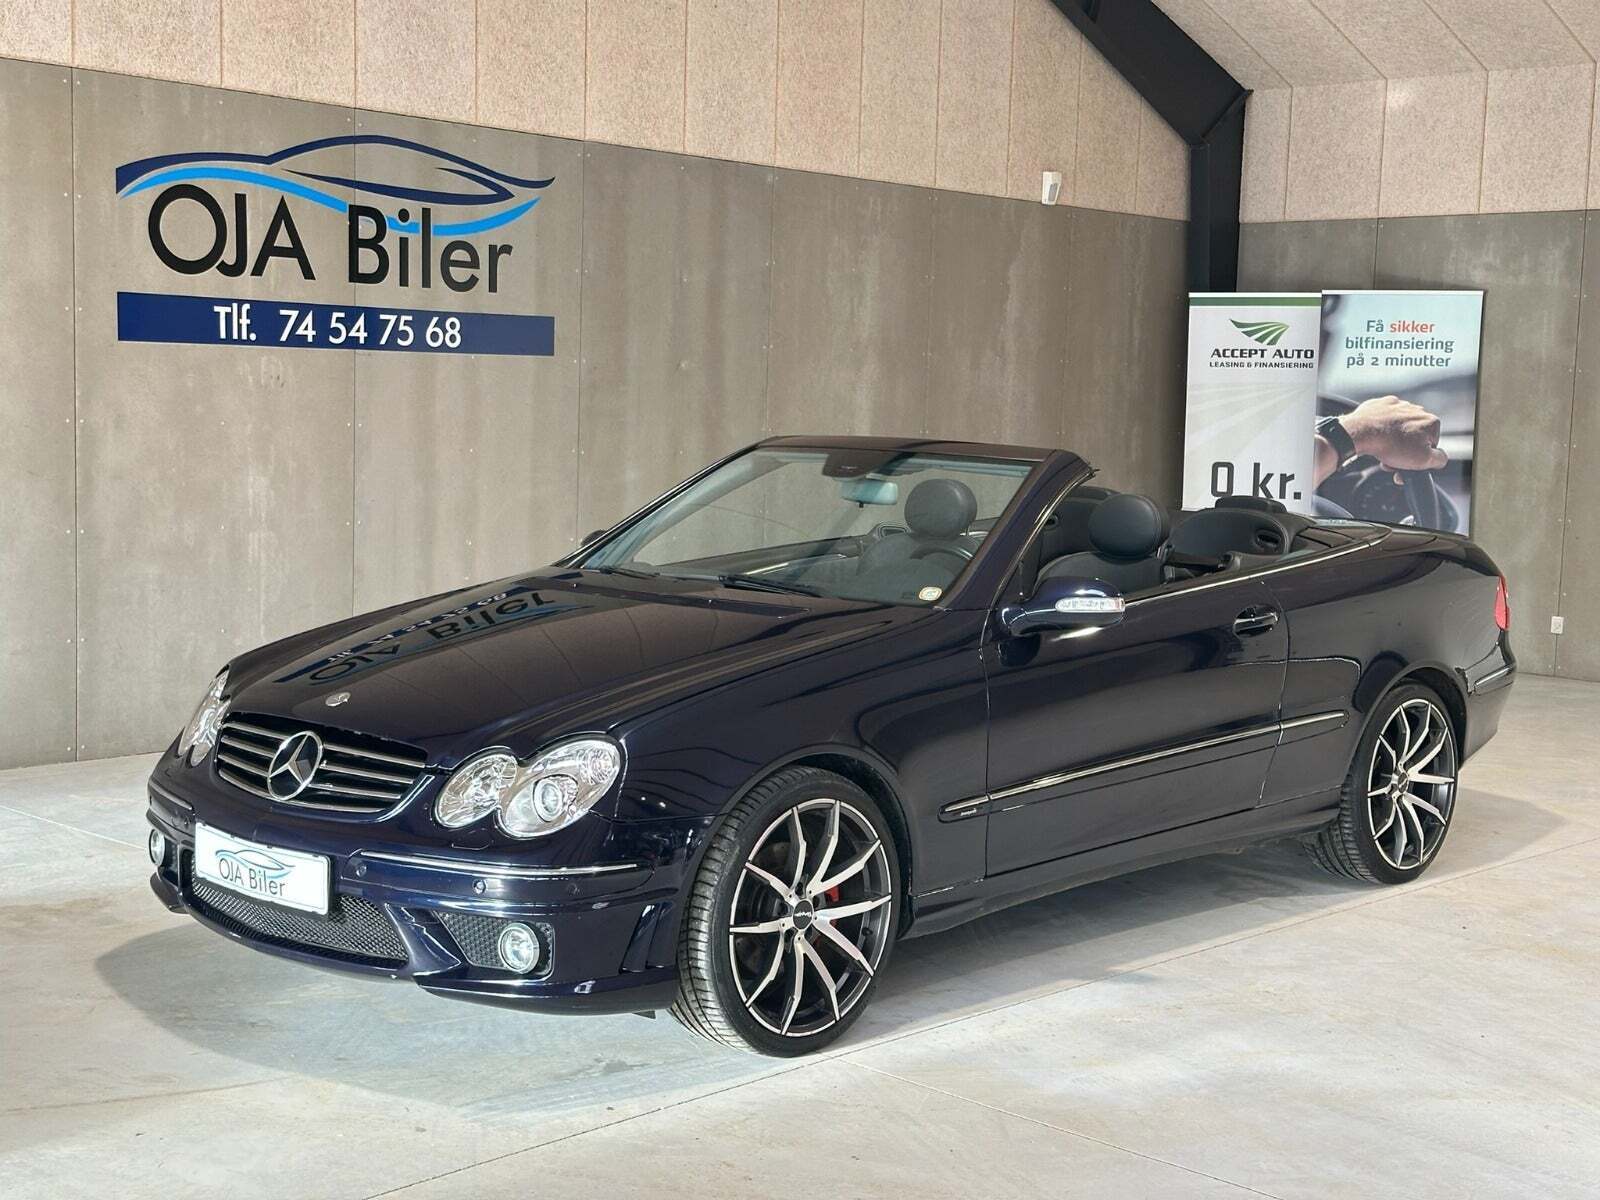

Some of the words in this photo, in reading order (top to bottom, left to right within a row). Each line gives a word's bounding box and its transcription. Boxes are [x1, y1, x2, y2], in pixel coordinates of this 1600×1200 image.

[147, 183, 317, 281] OJA
[347, 204, 513, 293] Biler
[213, 303, 257, 341] Tlf.
[278, 309, 316, 343] 74
[328, 311, 368, 345] 54
[379, 313, 414, 347] 75
[425, 316, 461, 349] 68
[1366, 319, 1384, 333] Få
[1389, 320, 1434, 333] sikker
[1210, 348, 1268, 359] ACCEPT
[1272, 348, 1314, 360] AUTO
[1345, 337, 1455, 353] bilfinansiering
[1346, 353, 1365, 369] på
[1371, 356, 1380, 366] 2
[1385, 354, 1451, 367] minutter
[1252, 462, 1302, 500] kr.
[218, 857, 244, 886] OJA
[248, 868, 286, 897] Biler
